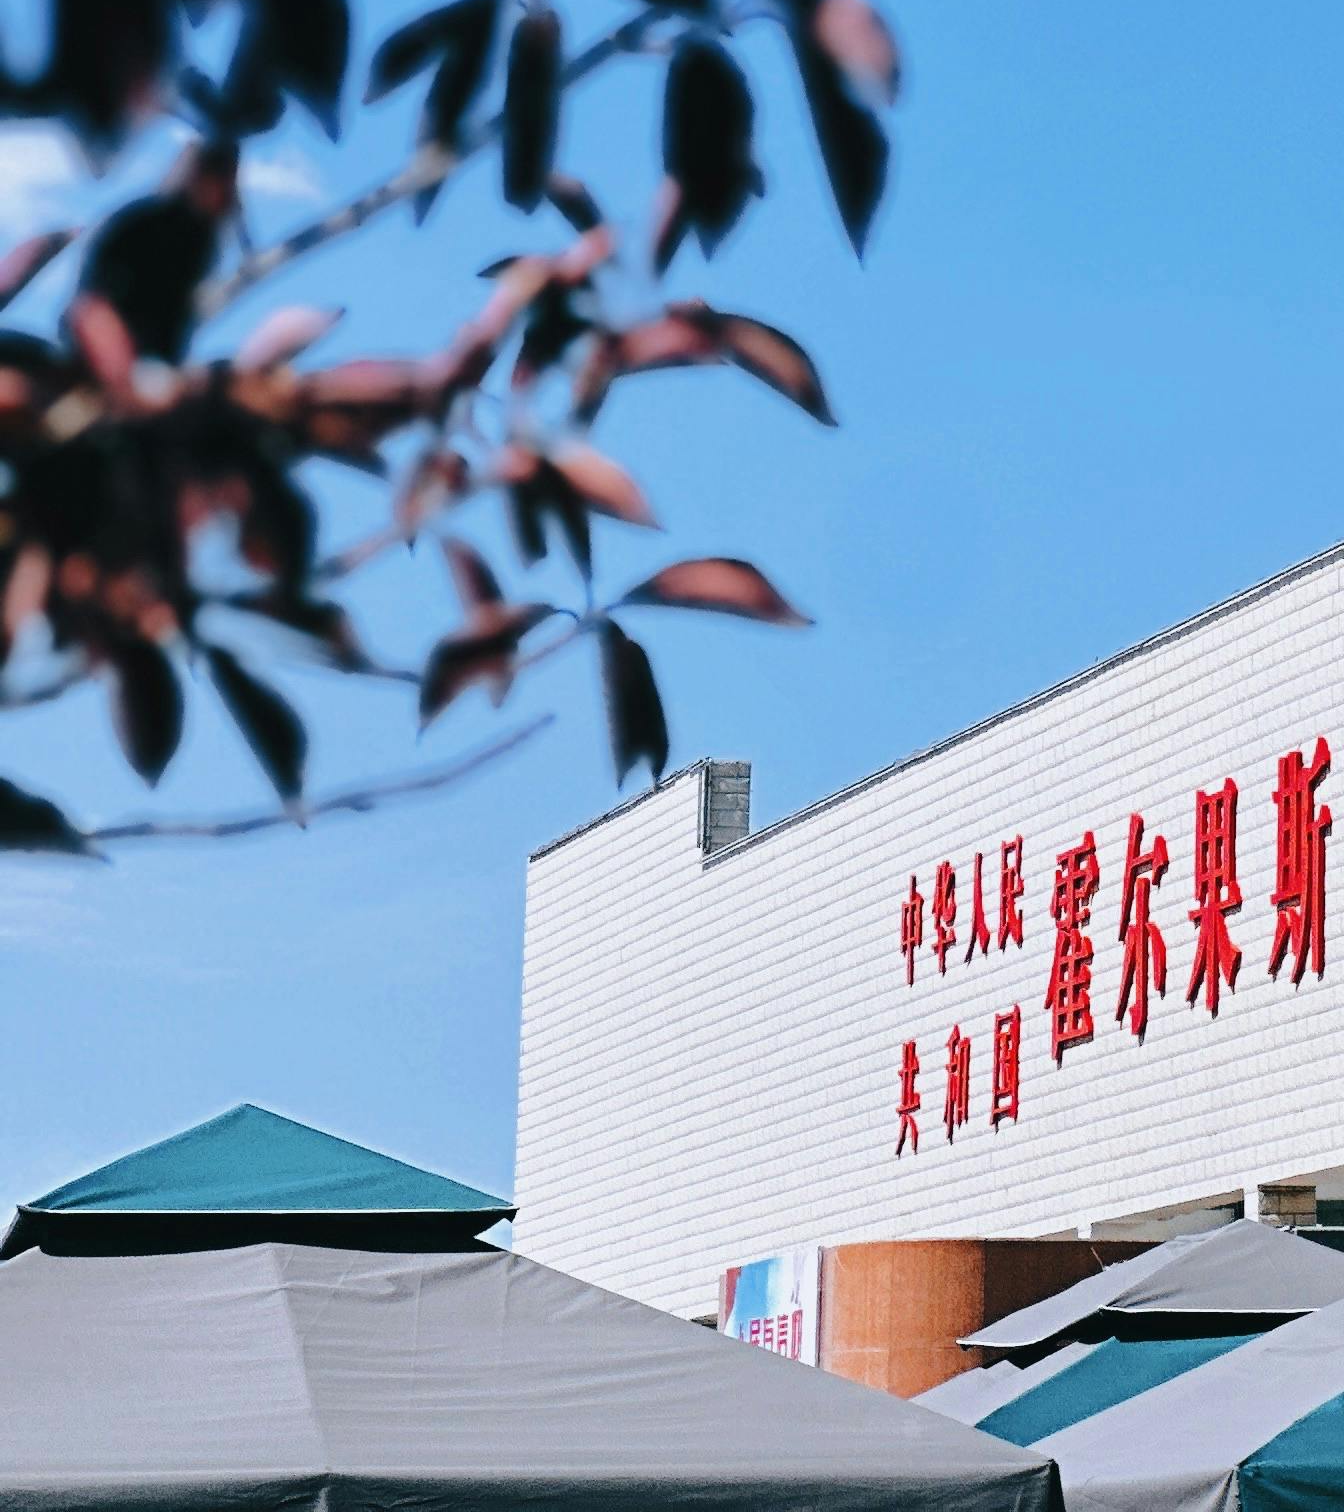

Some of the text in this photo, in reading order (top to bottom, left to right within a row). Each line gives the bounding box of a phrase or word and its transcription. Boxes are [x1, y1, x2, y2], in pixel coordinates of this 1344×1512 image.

[900, 834, 1026, 986] 中华人民
[895, 1003, 1022, 1155] 共和国
